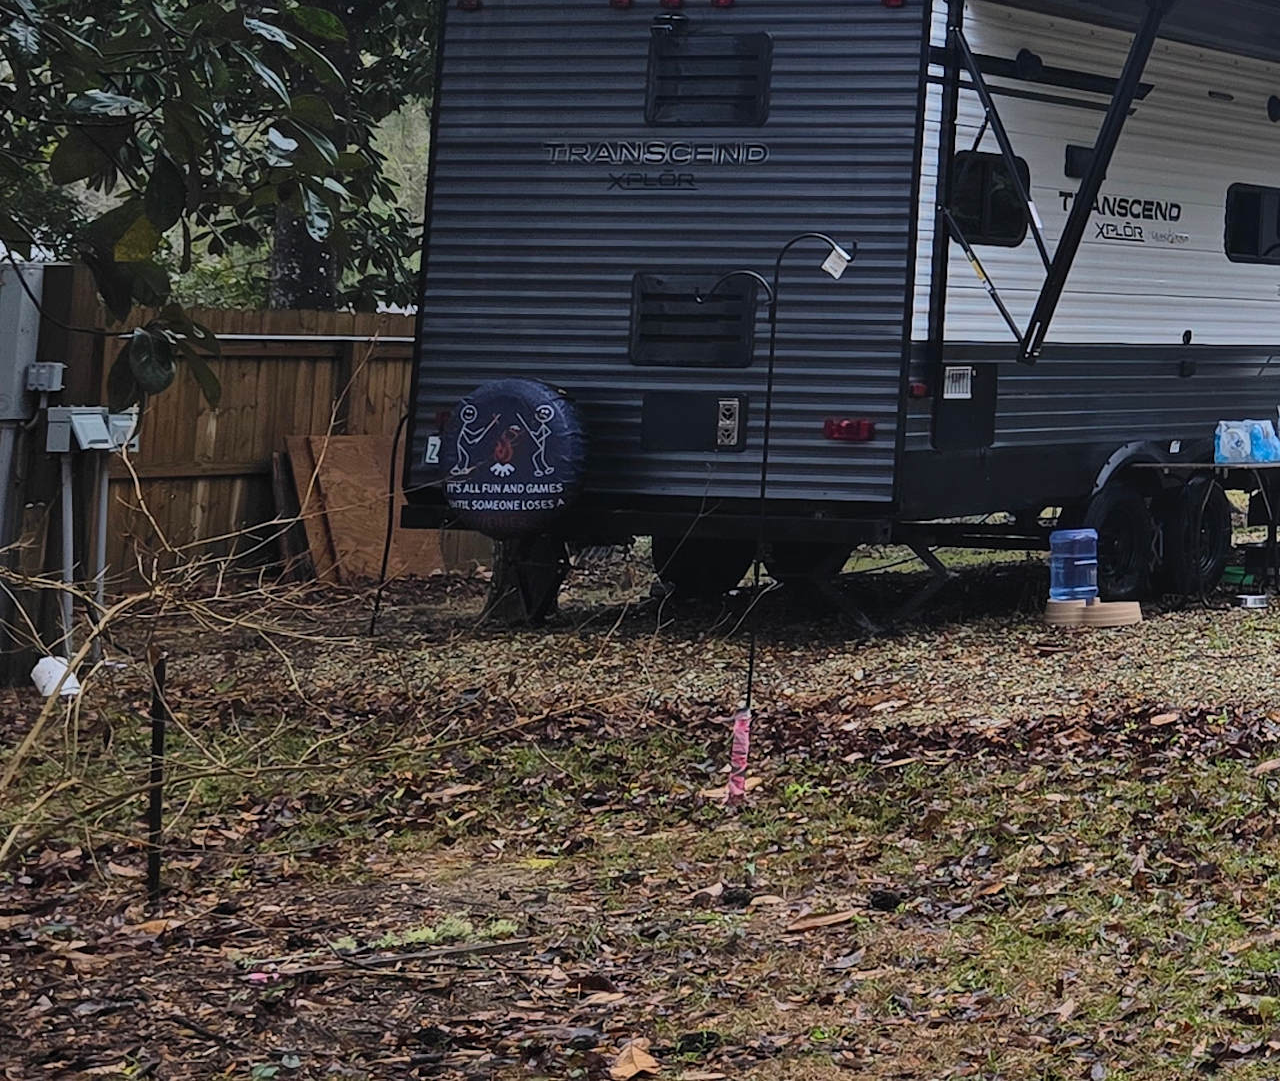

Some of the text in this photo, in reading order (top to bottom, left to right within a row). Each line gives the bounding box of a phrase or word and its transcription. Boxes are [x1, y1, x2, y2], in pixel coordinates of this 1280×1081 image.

[544, 141, 769, 165] TRANSCEND
[1058, 190, 1182, 222] TANSCEND
[463, 483, 480, 494] ALL
[482, 483, 501, 494] FUN
[503, 483, 525, 494] AND
[526, 483, 564, 494] GAMES
[472, 500, 520, 511] SOMEONE
[522, 498, 554, 511] LOSES
